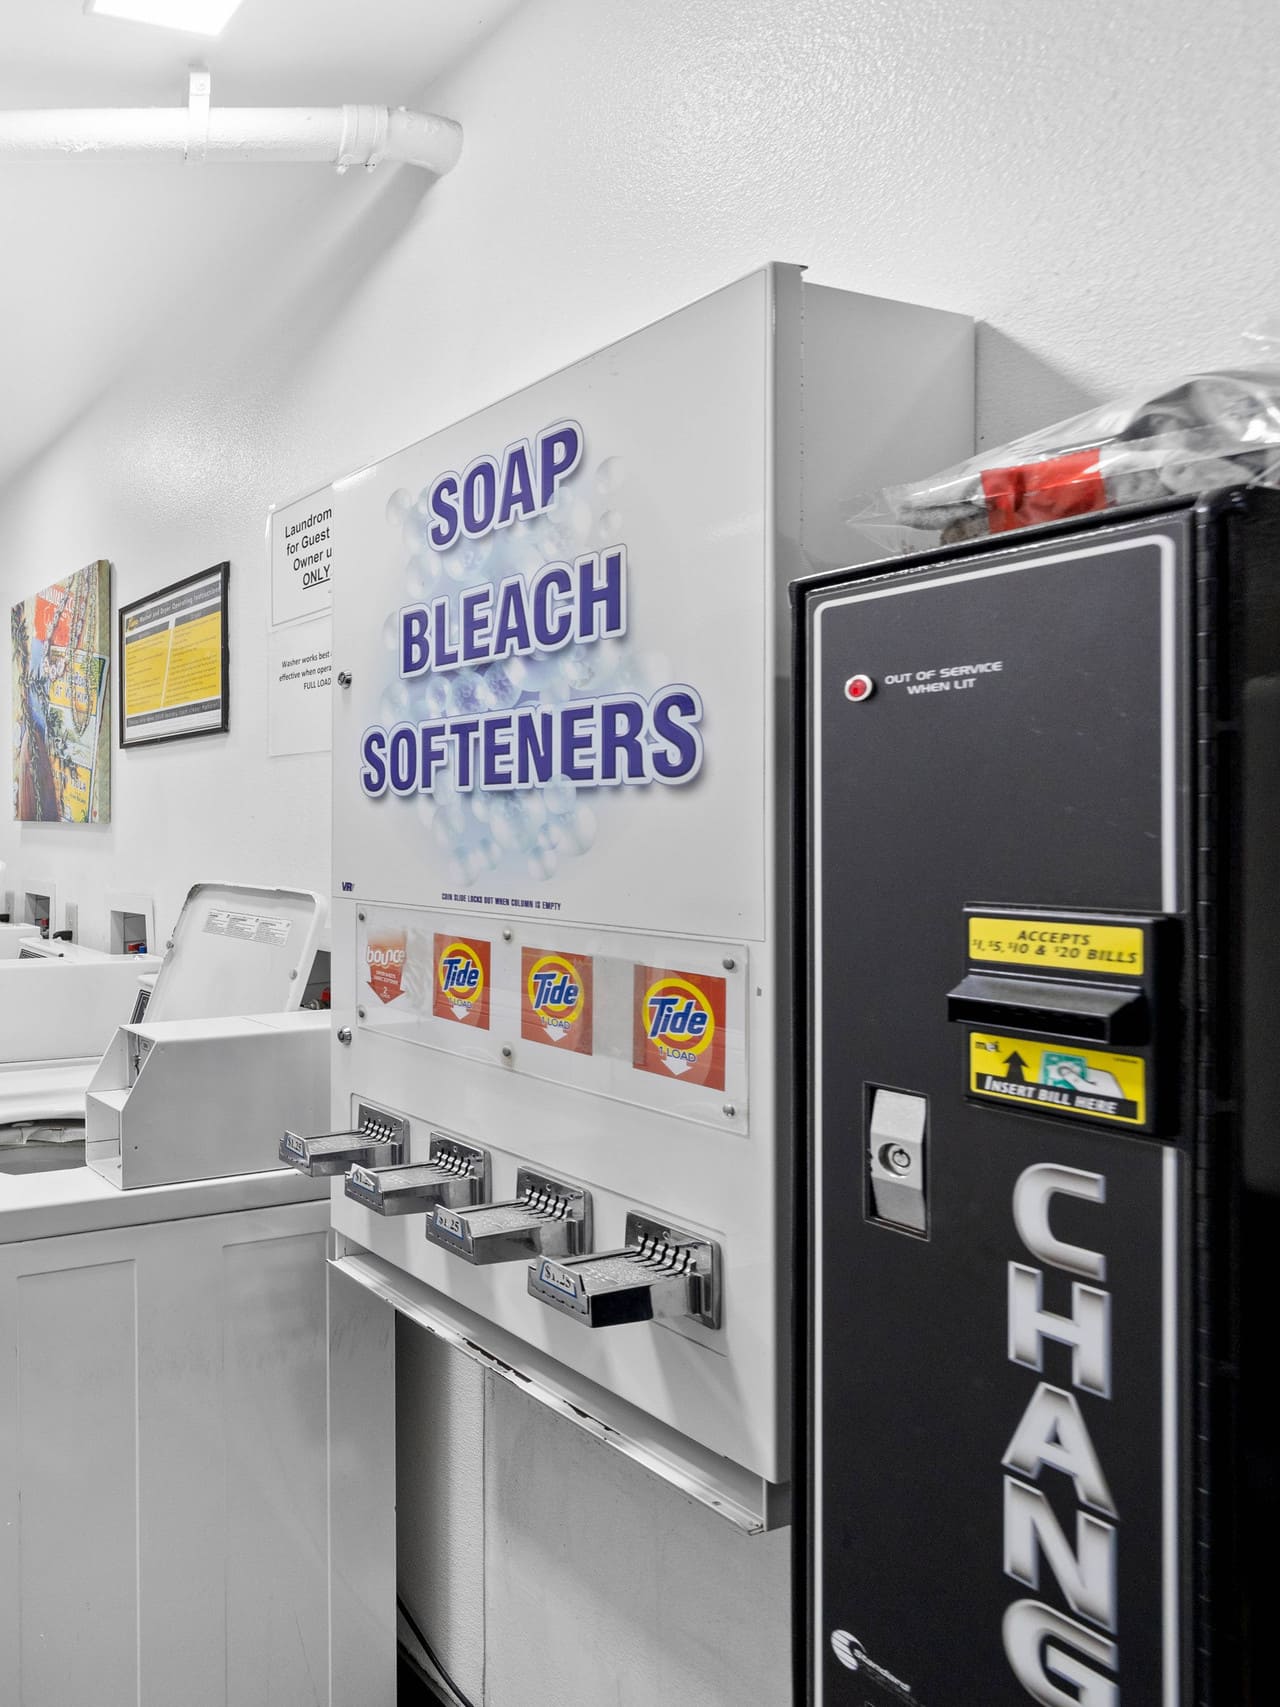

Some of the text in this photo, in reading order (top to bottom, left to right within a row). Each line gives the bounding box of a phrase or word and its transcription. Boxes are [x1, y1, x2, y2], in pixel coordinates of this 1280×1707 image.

[429, 422, 582, 548] SOAP
[285, 508, 332, 538] Laundrom
[287, 527, 330, 556] for Guest
[293, 547, 332, 571] Owner u
[302, 563, 331, 588] ONLY
[401, 548, 623, 677] BLEACH
[304, 678, 331, 690] FULL LOAD
[884, 661, 1003, 685] OUT OF SERVICE
[907, 678, 977, 695] WHEN LIT
[362, 691, 699, 794] SOFTENERS
[442, 893, 452, 901] COIN
[454, 894, 466, 902] SLIDE
[495, 898, 509, 906] WHEN
[511, 899, 533, 908] COLUMN
[535, 901, 540, 909] IS
[542, 902, 560, 910] EMPTY
[1017, 930, 1092, 946] ACCEPTS
[367, 945, 406, 966] bounce
[1008, 942, 1030, 954] $10
[1034, 945, 1046, 956] &
[1054, 946, 1080, 958] $20
[1087, 949, 1138, 964] BILLS
[442, 956, 480, 992] Tide
[532, 971, 580, 1010] Tide
[454, 999, 472, 1009] LOAD
[540, 1016, 570, 1030] 1 LOAD
[648, 996, 709, 1039] Tide
[659, 1046, 697, 1063] 1 LOAD
[984, 1075, 1118, 1115] INSERT BILL HERE
[439, 1214, 460, 1233] $125
[544, 1263, 571, 1289] $1.25
[1001, 1161, 1120, 1707] CHANG
